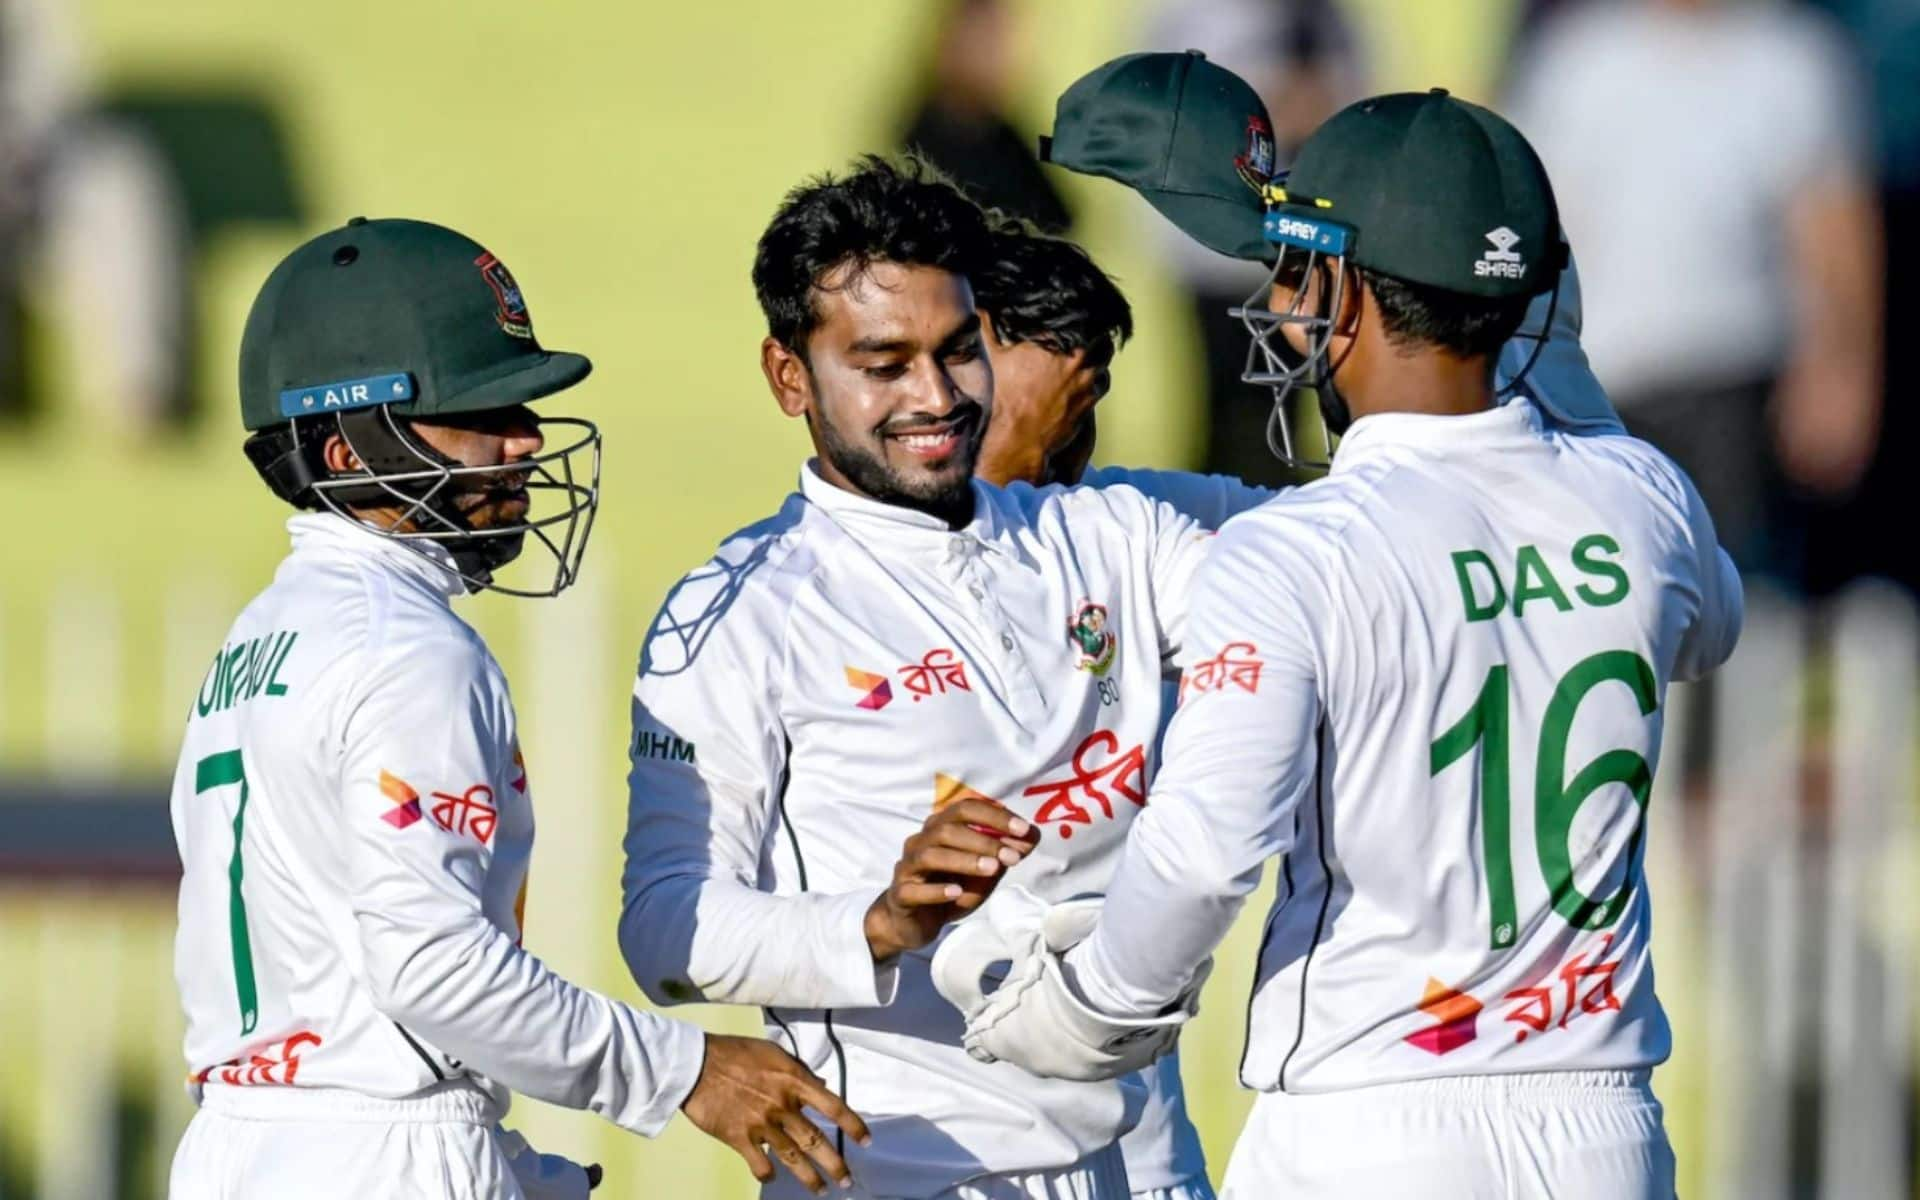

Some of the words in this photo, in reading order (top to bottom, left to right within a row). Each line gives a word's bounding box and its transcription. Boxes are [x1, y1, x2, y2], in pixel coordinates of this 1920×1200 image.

[1474, 260, 1527, 279] SHREY
[324, 384, 369, 408] AIR
[1450, 533, 1631, 623] DAS
[897, 648, 971, 702] রবি
[1097, 677, 1120, 706] 80
[634, 730, 696, 764] MHM
[1023, 729, 1147, 840] রবি
[1430, 649, 1658, 951] 16
[196, 748, 259, 1037] 7
[1503, 933, 1621, 1044] রবি
